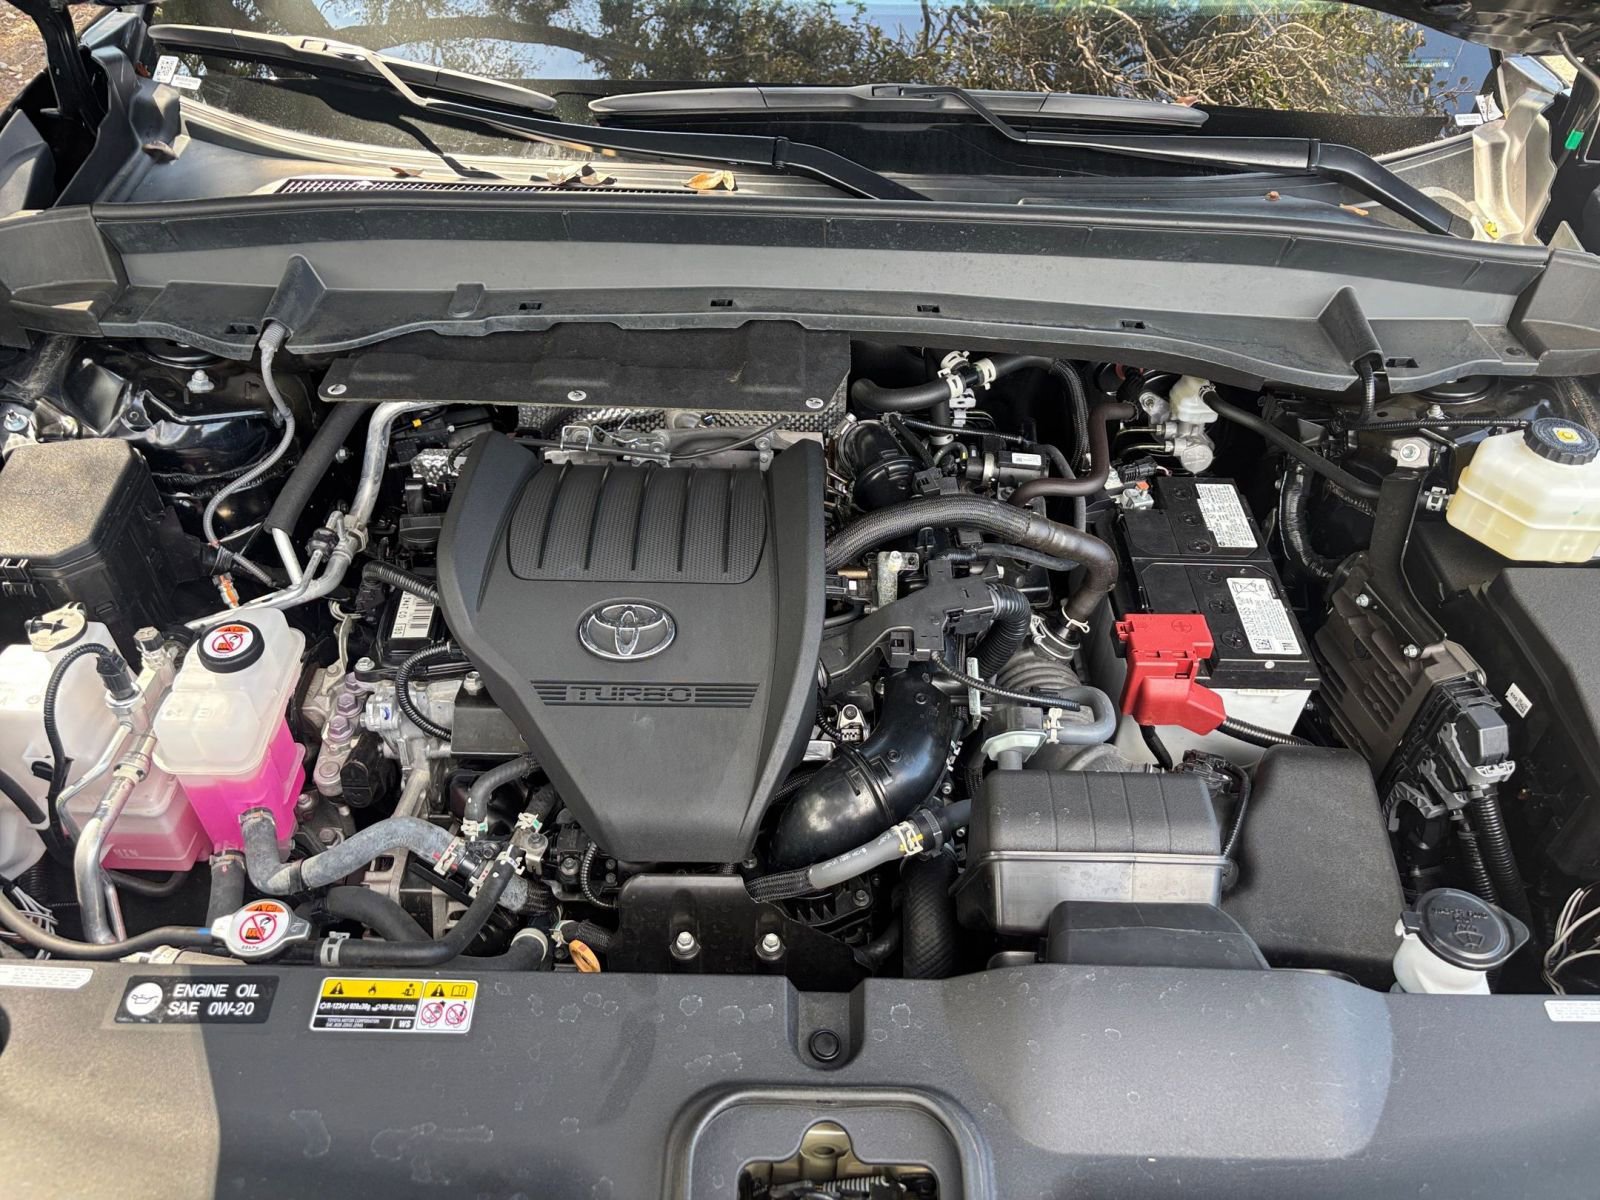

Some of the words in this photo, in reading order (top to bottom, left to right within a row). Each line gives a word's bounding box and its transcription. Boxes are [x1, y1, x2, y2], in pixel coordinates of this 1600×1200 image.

[568, 686, 693, 703] TURBO
[173, 984, 228, 997] ENGINE
[236, 984, 259, 997] OIL
[167, 1002, 200, 1015] SAE
[208, 1002, 254, 1015] 0W-20
